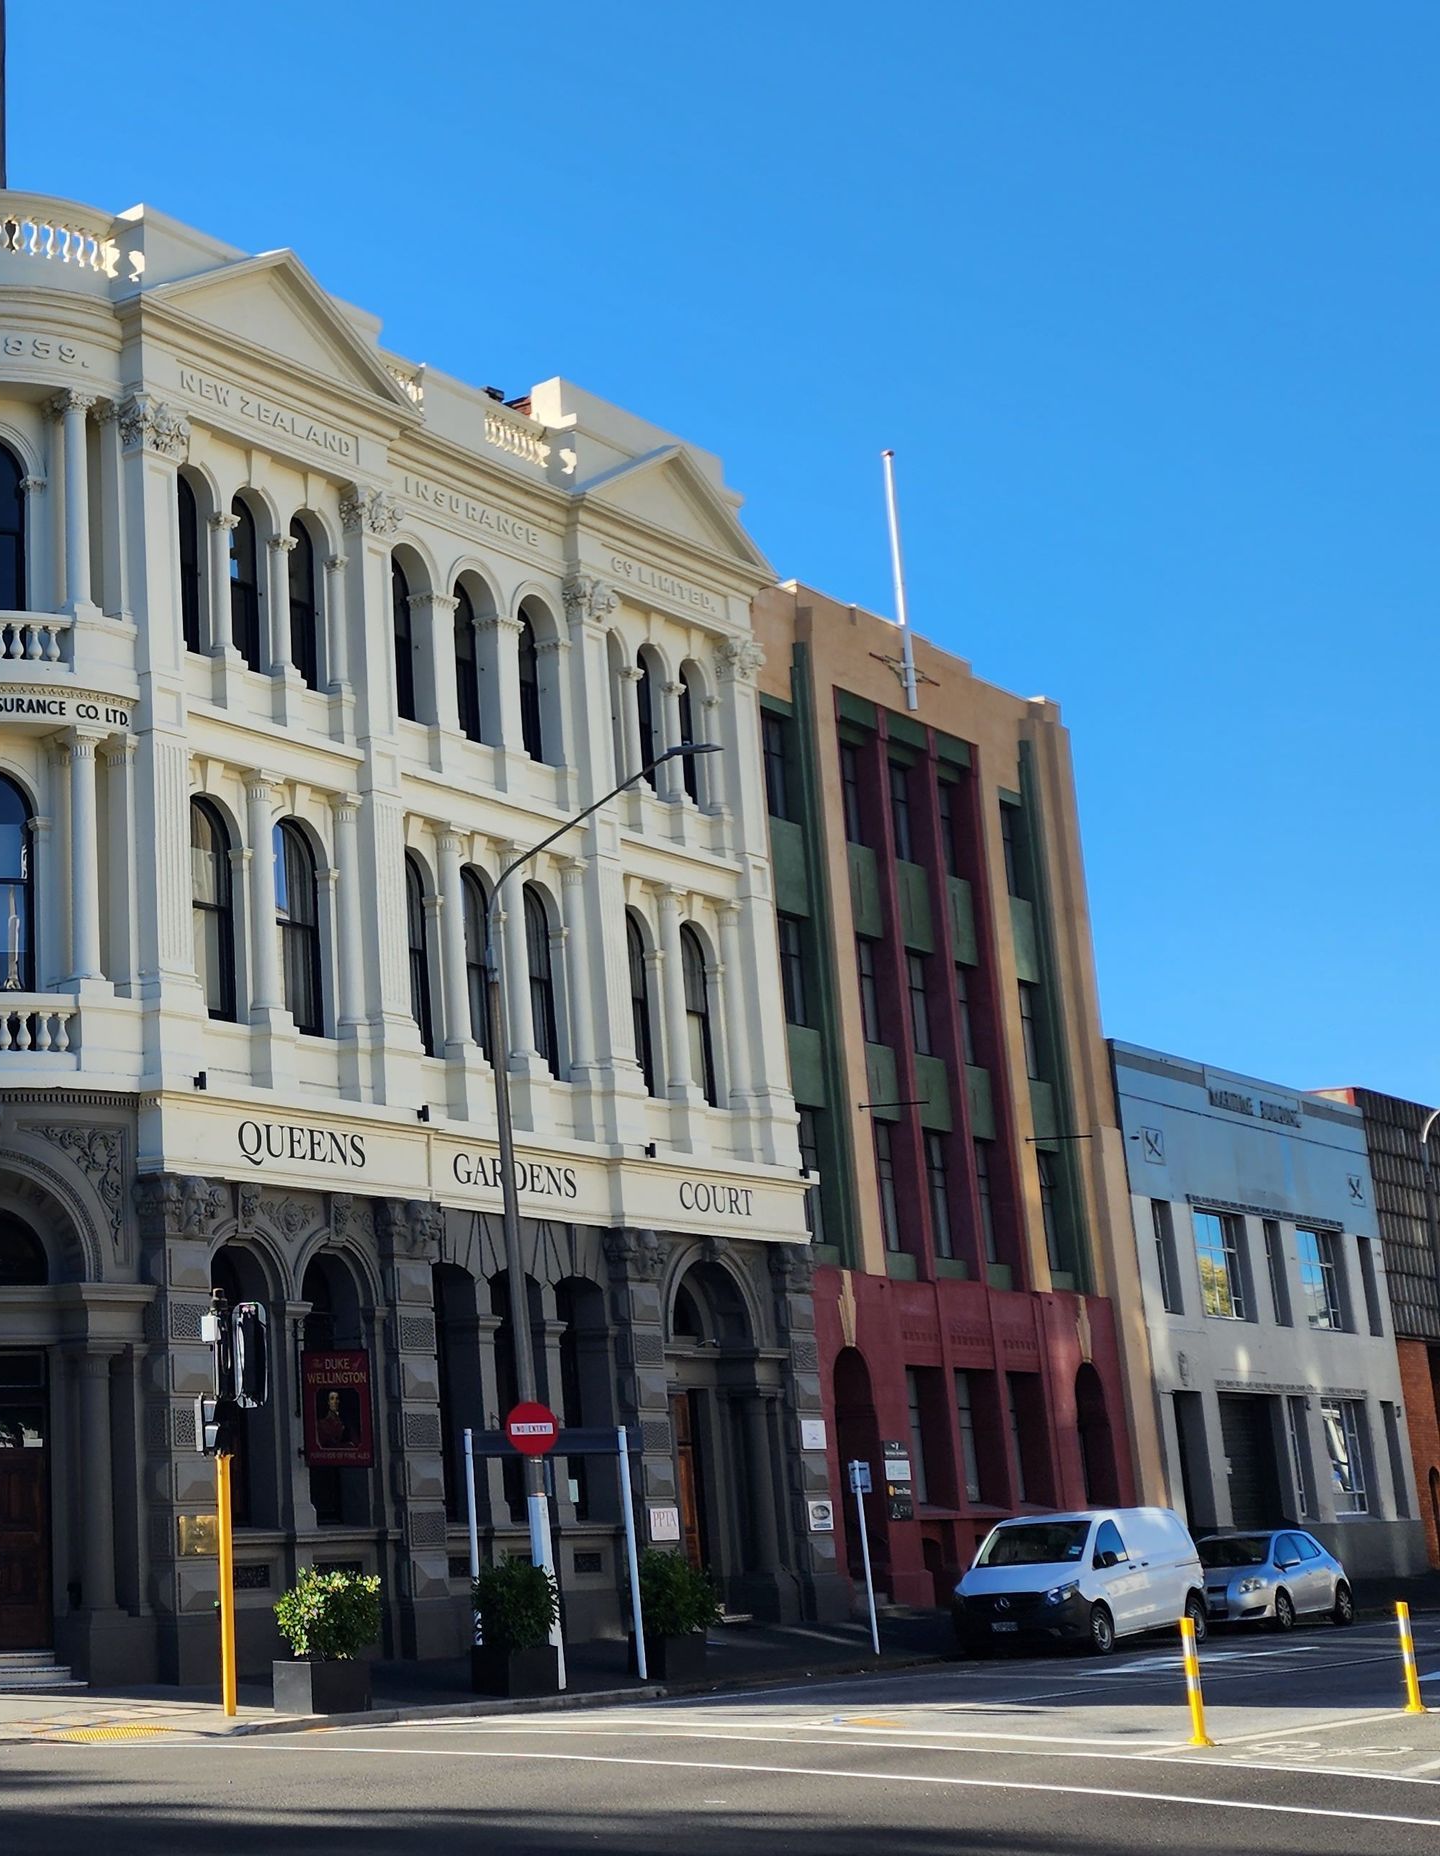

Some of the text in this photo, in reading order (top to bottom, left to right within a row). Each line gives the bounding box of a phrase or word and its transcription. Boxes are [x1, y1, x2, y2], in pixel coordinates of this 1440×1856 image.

[180, 370, 352, 457] NEW ZEALAND
[405, 476, 539, 547] INSURANCE
[76, 703, 101, 721] CO.
[105, 708, 129, 727] LTD.
[238, 1121, 366, 1168] QUEENS
[679, 1182, 753, 1216] COURT
[307, 1371, 367, 1384] WELLINGTON
[325, 1358, 350, 1370] DUKE
[528, 1424, 547, 1433] ENTRY
